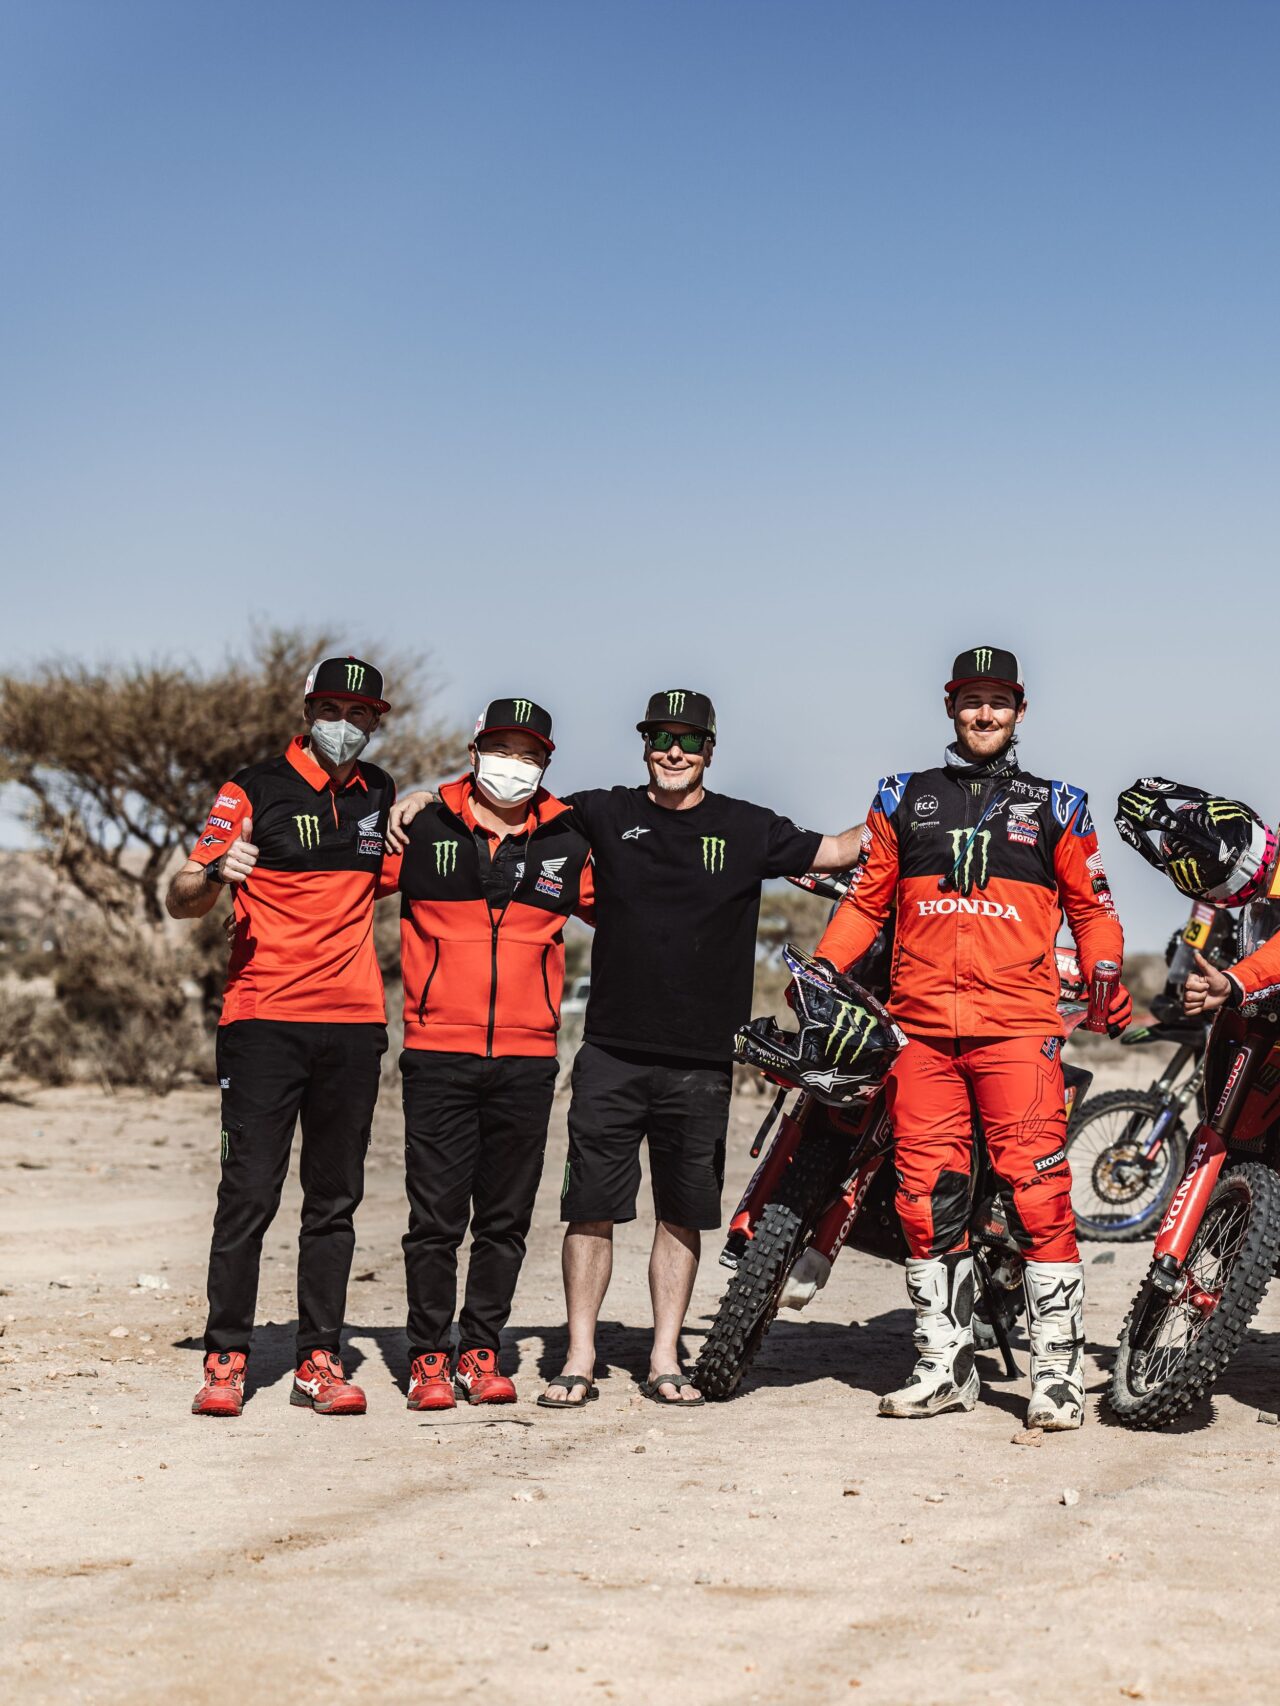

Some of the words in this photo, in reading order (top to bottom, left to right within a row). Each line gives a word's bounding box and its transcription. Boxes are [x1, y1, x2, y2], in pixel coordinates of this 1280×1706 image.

[1009, 786, 1026, 795] AIR
[1028, 790, 1049, 801] BAG
[1009, 814, 1039, 827] HONDA
[539, 870, 563, 884] HONDA
[1089, 869, 1105, 878] HON
[917, 898, 1022, 922] HONDA
[1060, 988, 1077, 999] TUL
[756, 1047, 791, 1067] MONSTER
[1160, 1142, 1208, 1236] HONDA
[829, 1170, 875, 1257] HONDA
